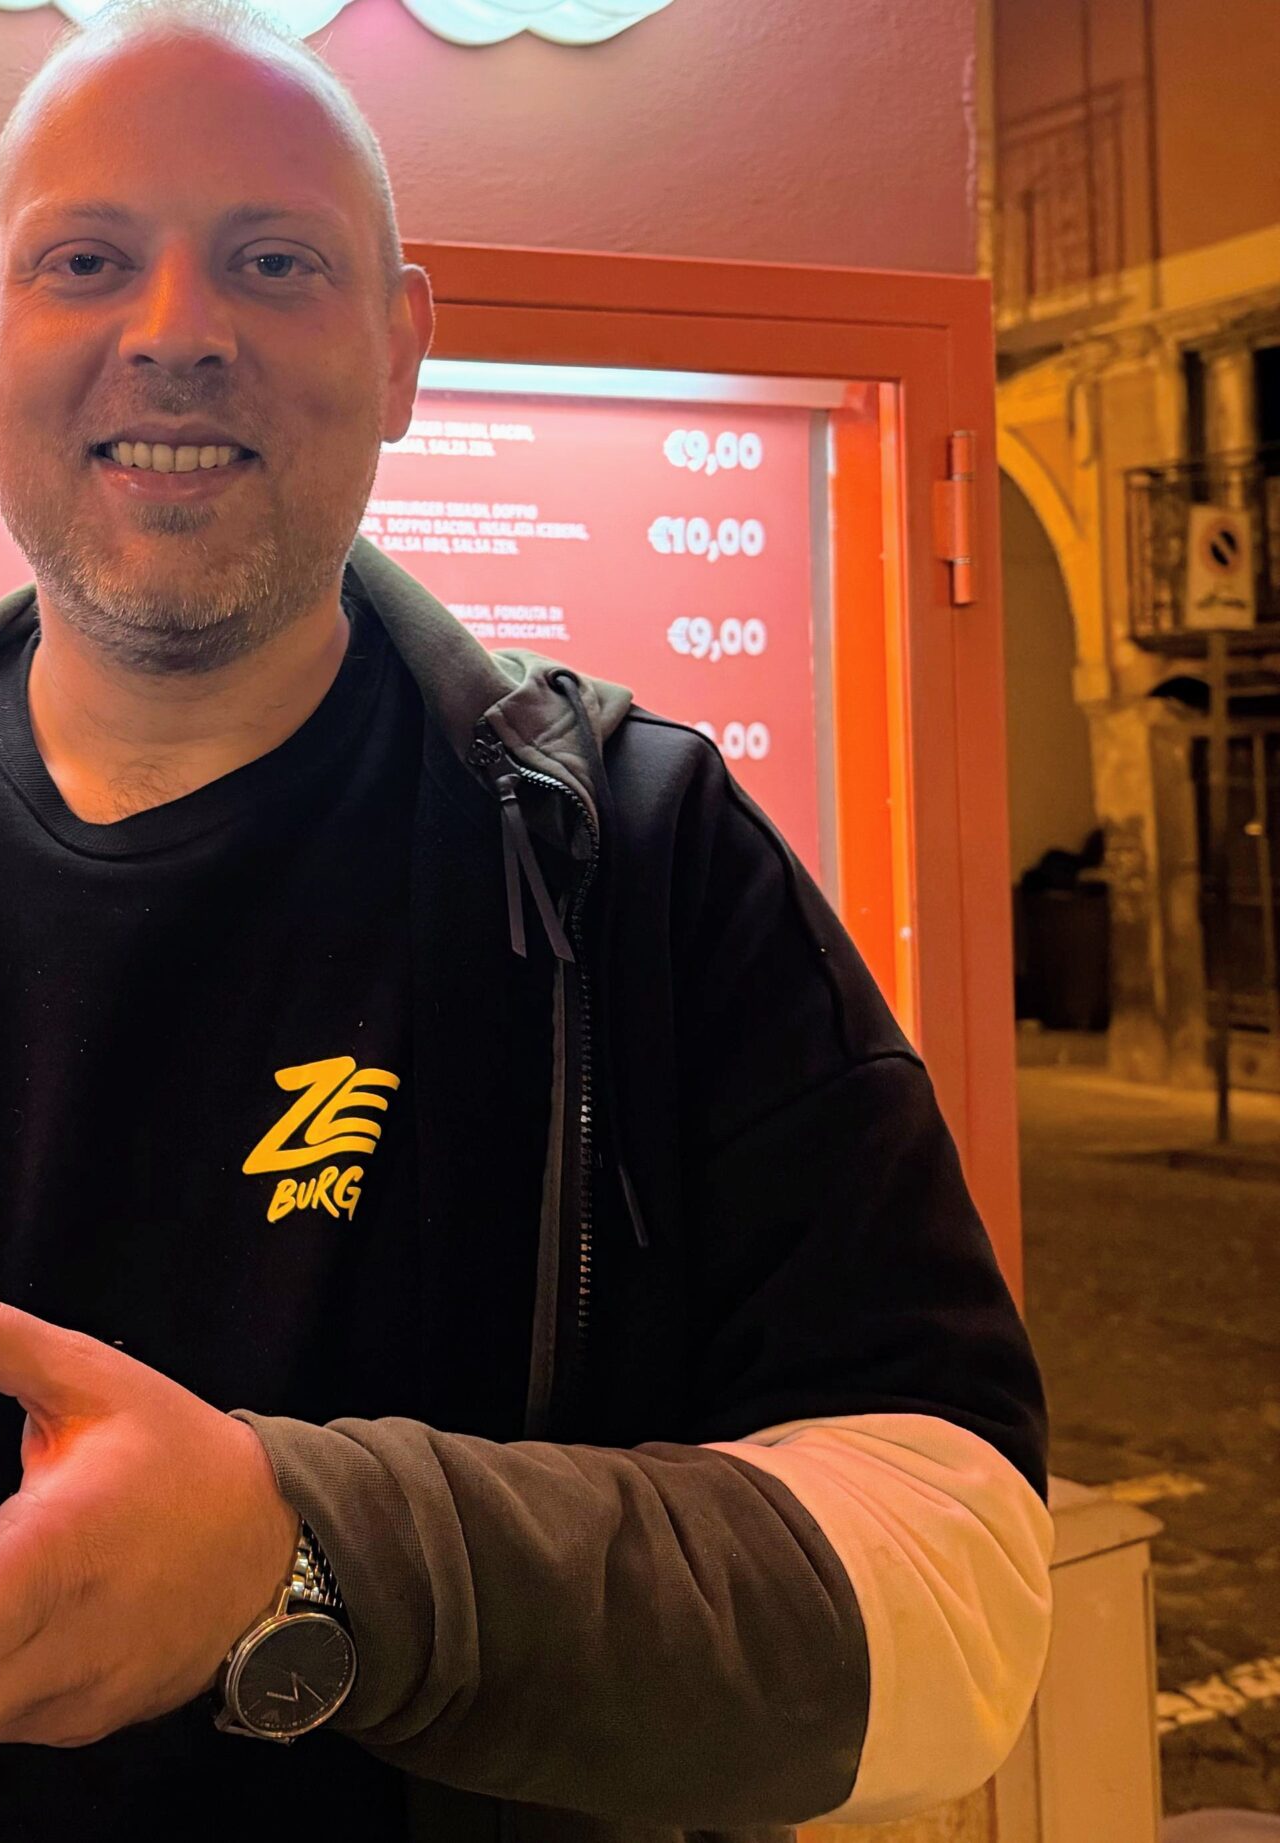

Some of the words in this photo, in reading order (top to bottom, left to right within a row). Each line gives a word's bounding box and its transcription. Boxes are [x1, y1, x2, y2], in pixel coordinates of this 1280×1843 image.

[663, 429, 763, 476] €9,00
[647, 516, 765, 563] €10,00
[666, 616, 768, 663] €9,00
[242, 1055, 401, 1175] ZE
[267, 1165, 364, 1223] BURG
